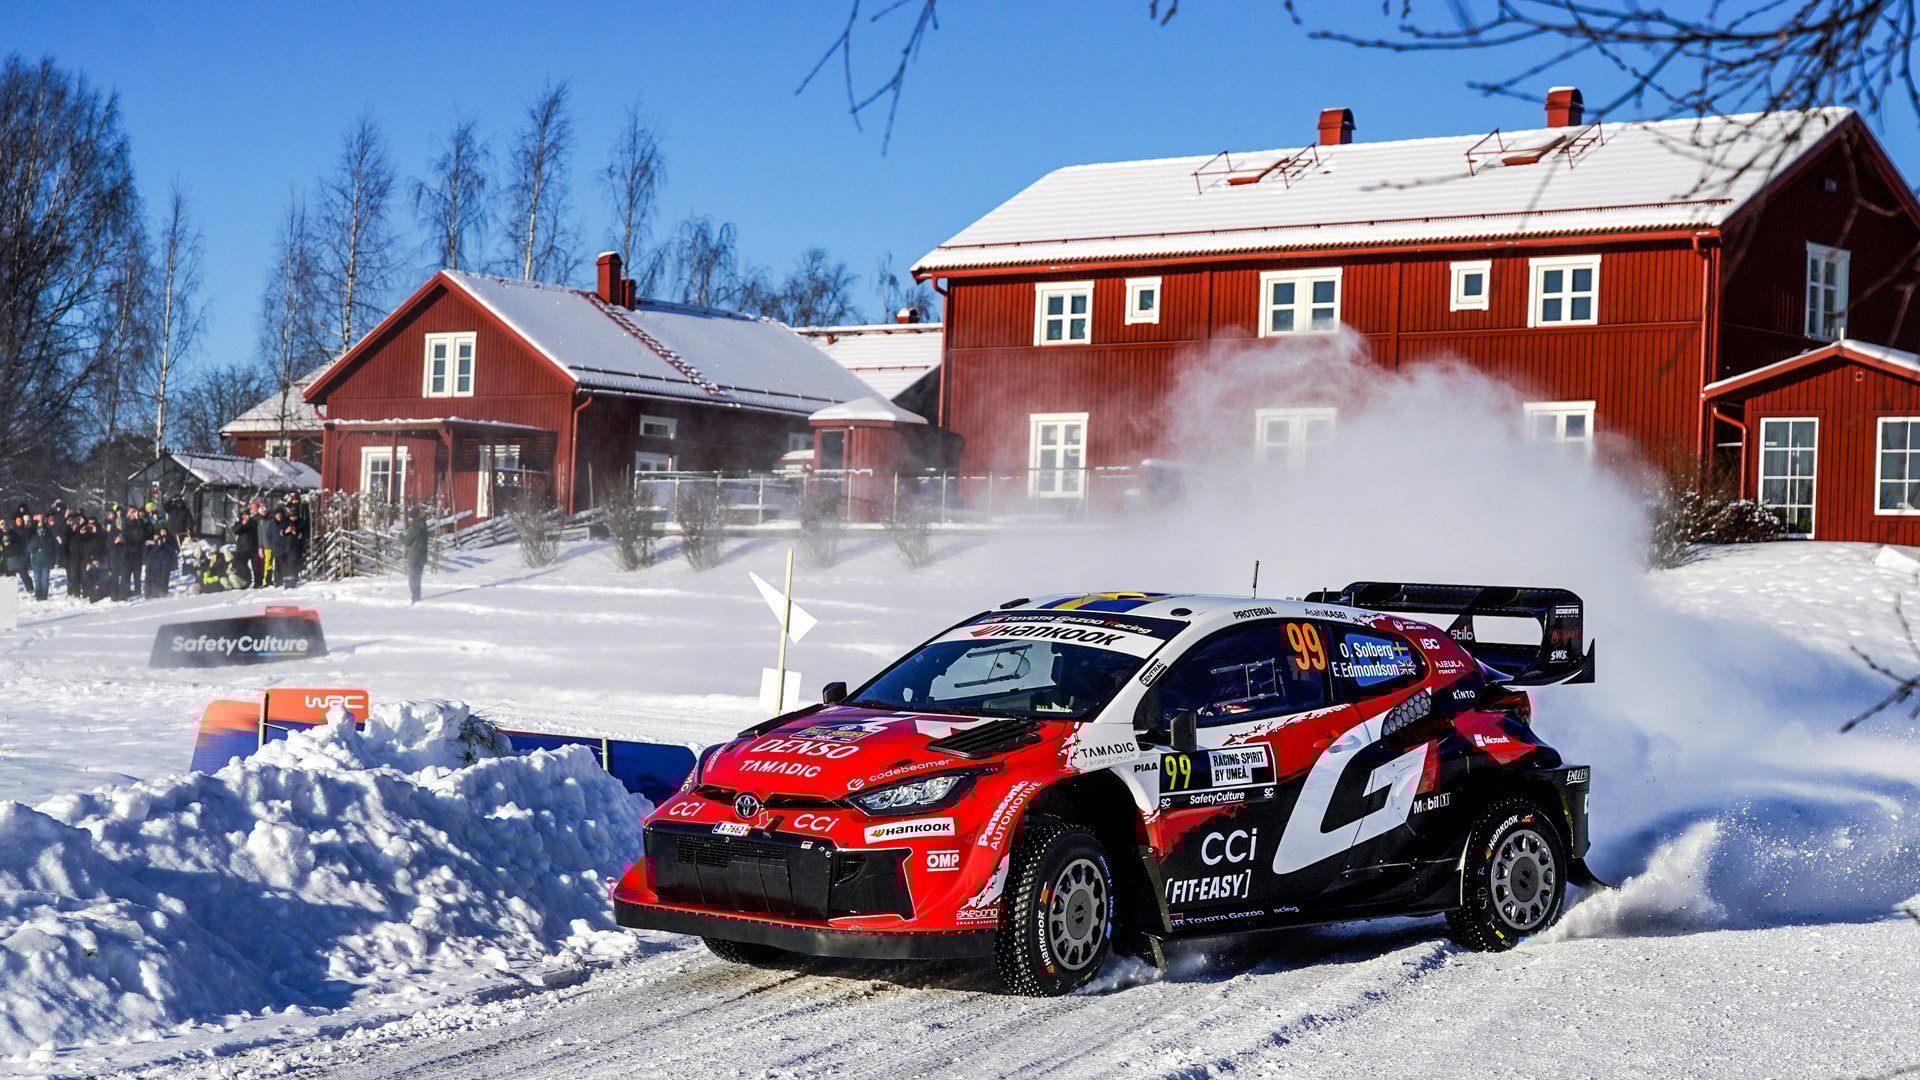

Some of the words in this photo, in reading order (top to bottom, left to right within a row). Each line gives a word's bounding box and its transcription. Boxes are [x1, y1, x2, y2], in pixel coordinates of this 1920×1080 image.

[1233, 607, 1277, 619] PROTERIAL
[1450, 626, 1474, 640] Stilo
[172, 635, 308, 656] SafetyCulture
[1286, 623, 1326, 671] 99
[1340, 643, 1353, 658] O.
[1354, 643, 1394, 659] Solberg
[1142, 661, 1165, 685] CENTRAL
[305, 695, 364, 709] WRC
[1483, 736, 1510, 744] Microsoft
[750, 739, 860, 759] DENSO
[1080, 742, 1135, 759] TAMADIC
[1213, 753, 1240, 767] RACING
[1241, 751, 1264, 764] SPIRIT
[739, 760, 822, 778] TAMADIC
[869, 760, 951, 782] codebeamer
[1134, 762, 1158, 773] PIAA
[1165, 755, 1191, 790] 99
[1215, 769, 1224, 781] BY
[1226, 765, 1249, 780] UMEÅ.
[1190, 791, 1245, 805] SafetyCulture
[1264, 787, 1274, 797] SC
[669, 802, 707, 816] CCi
[1160, 798, 1171, 807] SC
[1414, 795, 1439, 814] Mobil
[978, 780, 1029, 847] Panasonic
[990, 780, 1042, 850] AUTOMOTIVE
[720, 823, 744, 834] A-7662
[793, 814, 839, 832] CCi
[1201, 828, 1257, 866] CCi
[927, 854, 960, 867] OMP
[1186, 915, 1228, 925] TOYOTA
[1229, 910, 1265, 919] GAZOO
